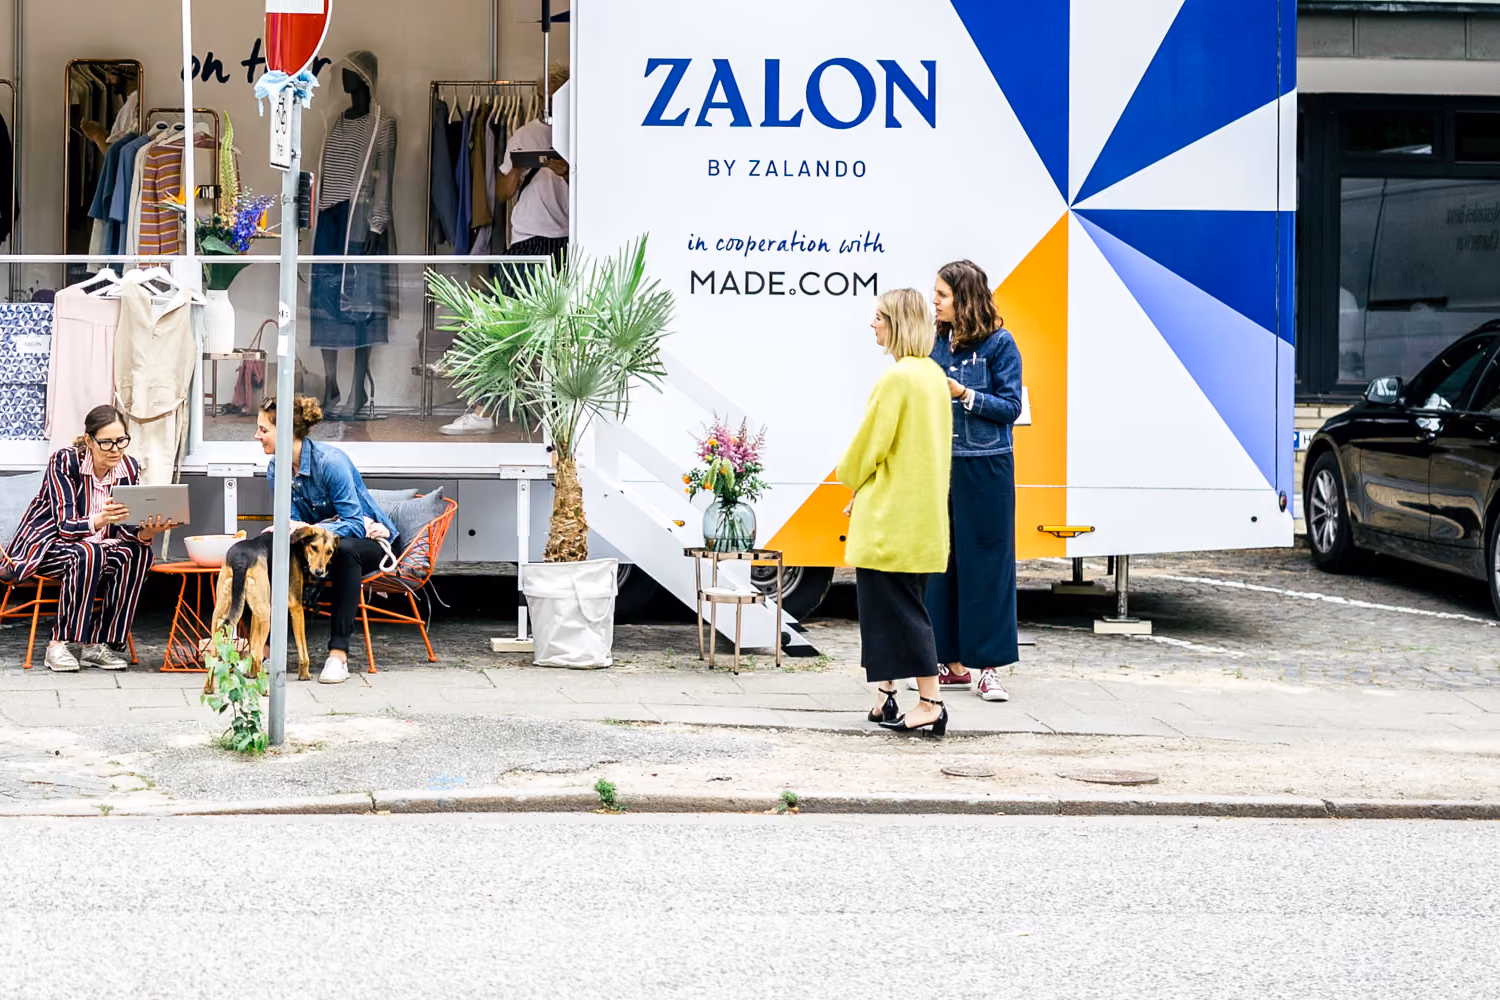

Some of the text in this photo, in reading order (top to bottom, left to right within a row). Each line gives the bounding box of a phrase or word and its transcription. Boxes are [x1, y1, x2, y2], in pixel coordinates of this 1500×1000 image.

[241, 38, 332, 83] tr
[641, 57, 937, 130] ZALON
[708, 160, 867, 178] BY ZALANDO
[687, 230, 886, 257] in cooperation with
